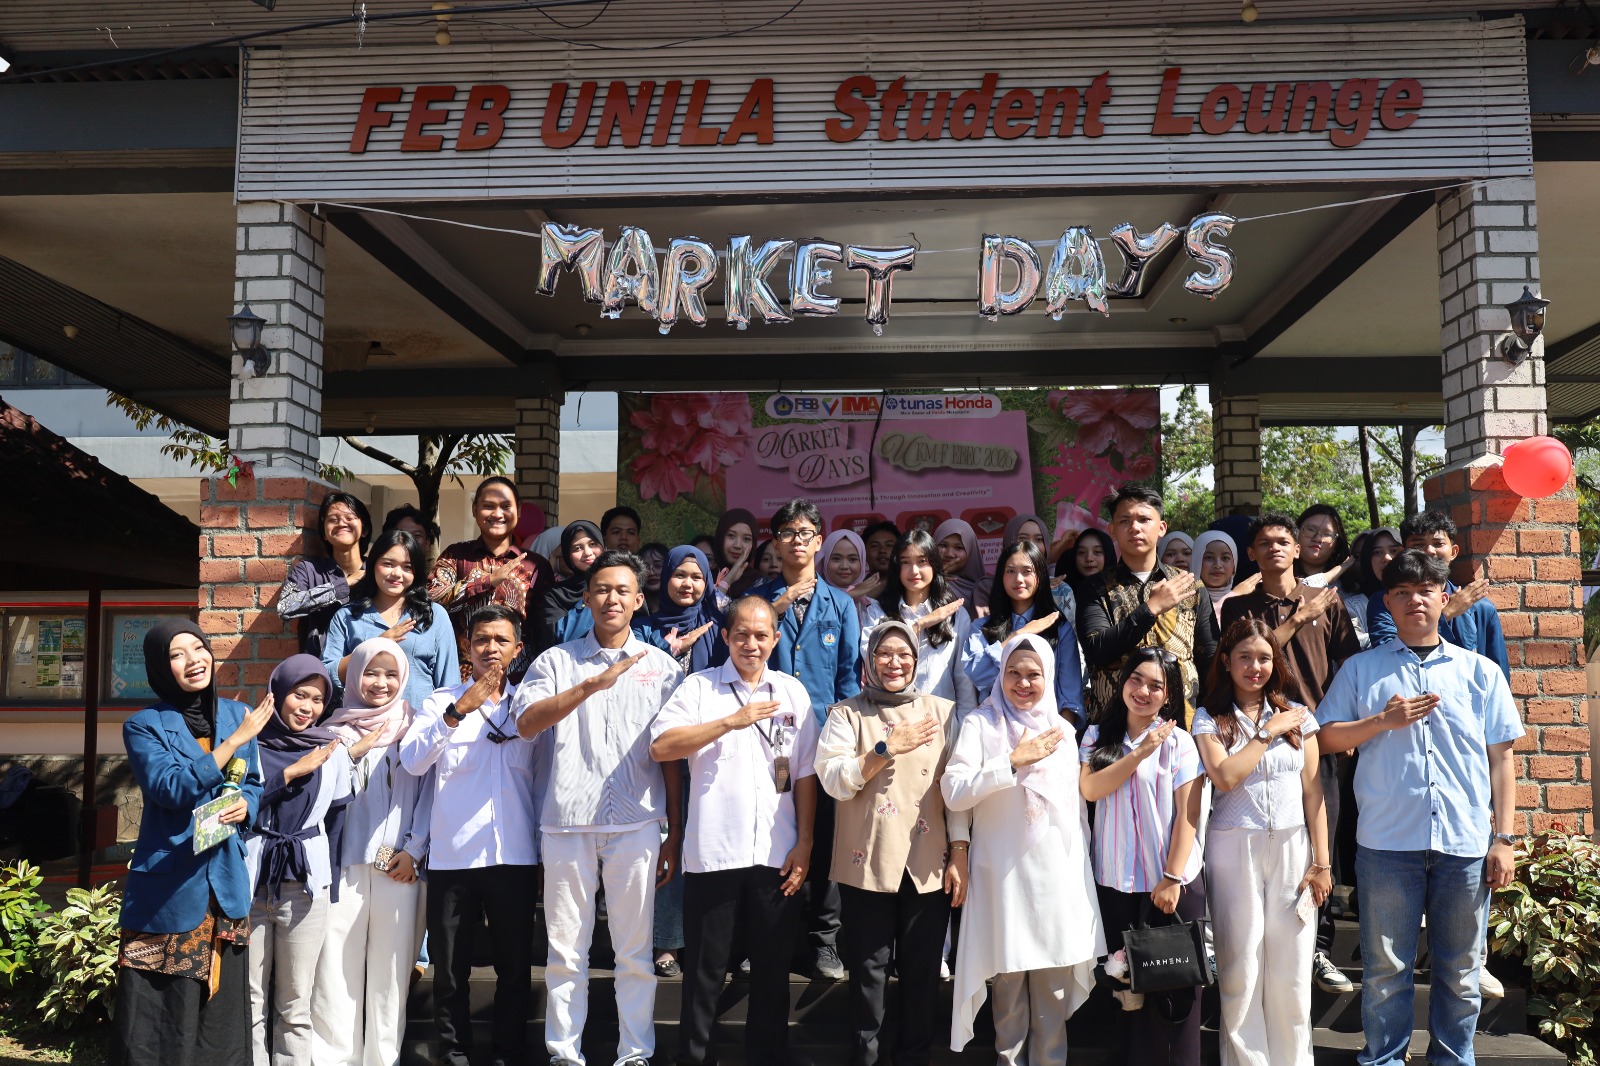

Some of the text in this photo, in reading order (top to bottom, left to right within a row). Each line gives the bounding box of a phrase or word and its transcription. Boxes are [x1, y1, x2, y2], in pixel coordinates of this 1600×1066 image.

[349, 67, 1424, 153] FEB UNILA Student Lounge
[535, 211, 1237, 336] MARKET DAYS
[794, 398, 819, 410] FEB
[899, 396, 993, 410] tunas Honda
[757, 427, 840, 459] MARKET
[798, 454, 865, 483] DAYS
[907, 491, 940, 499] Innovation
[1142, 957, 1189, 968] MARHEN.J
